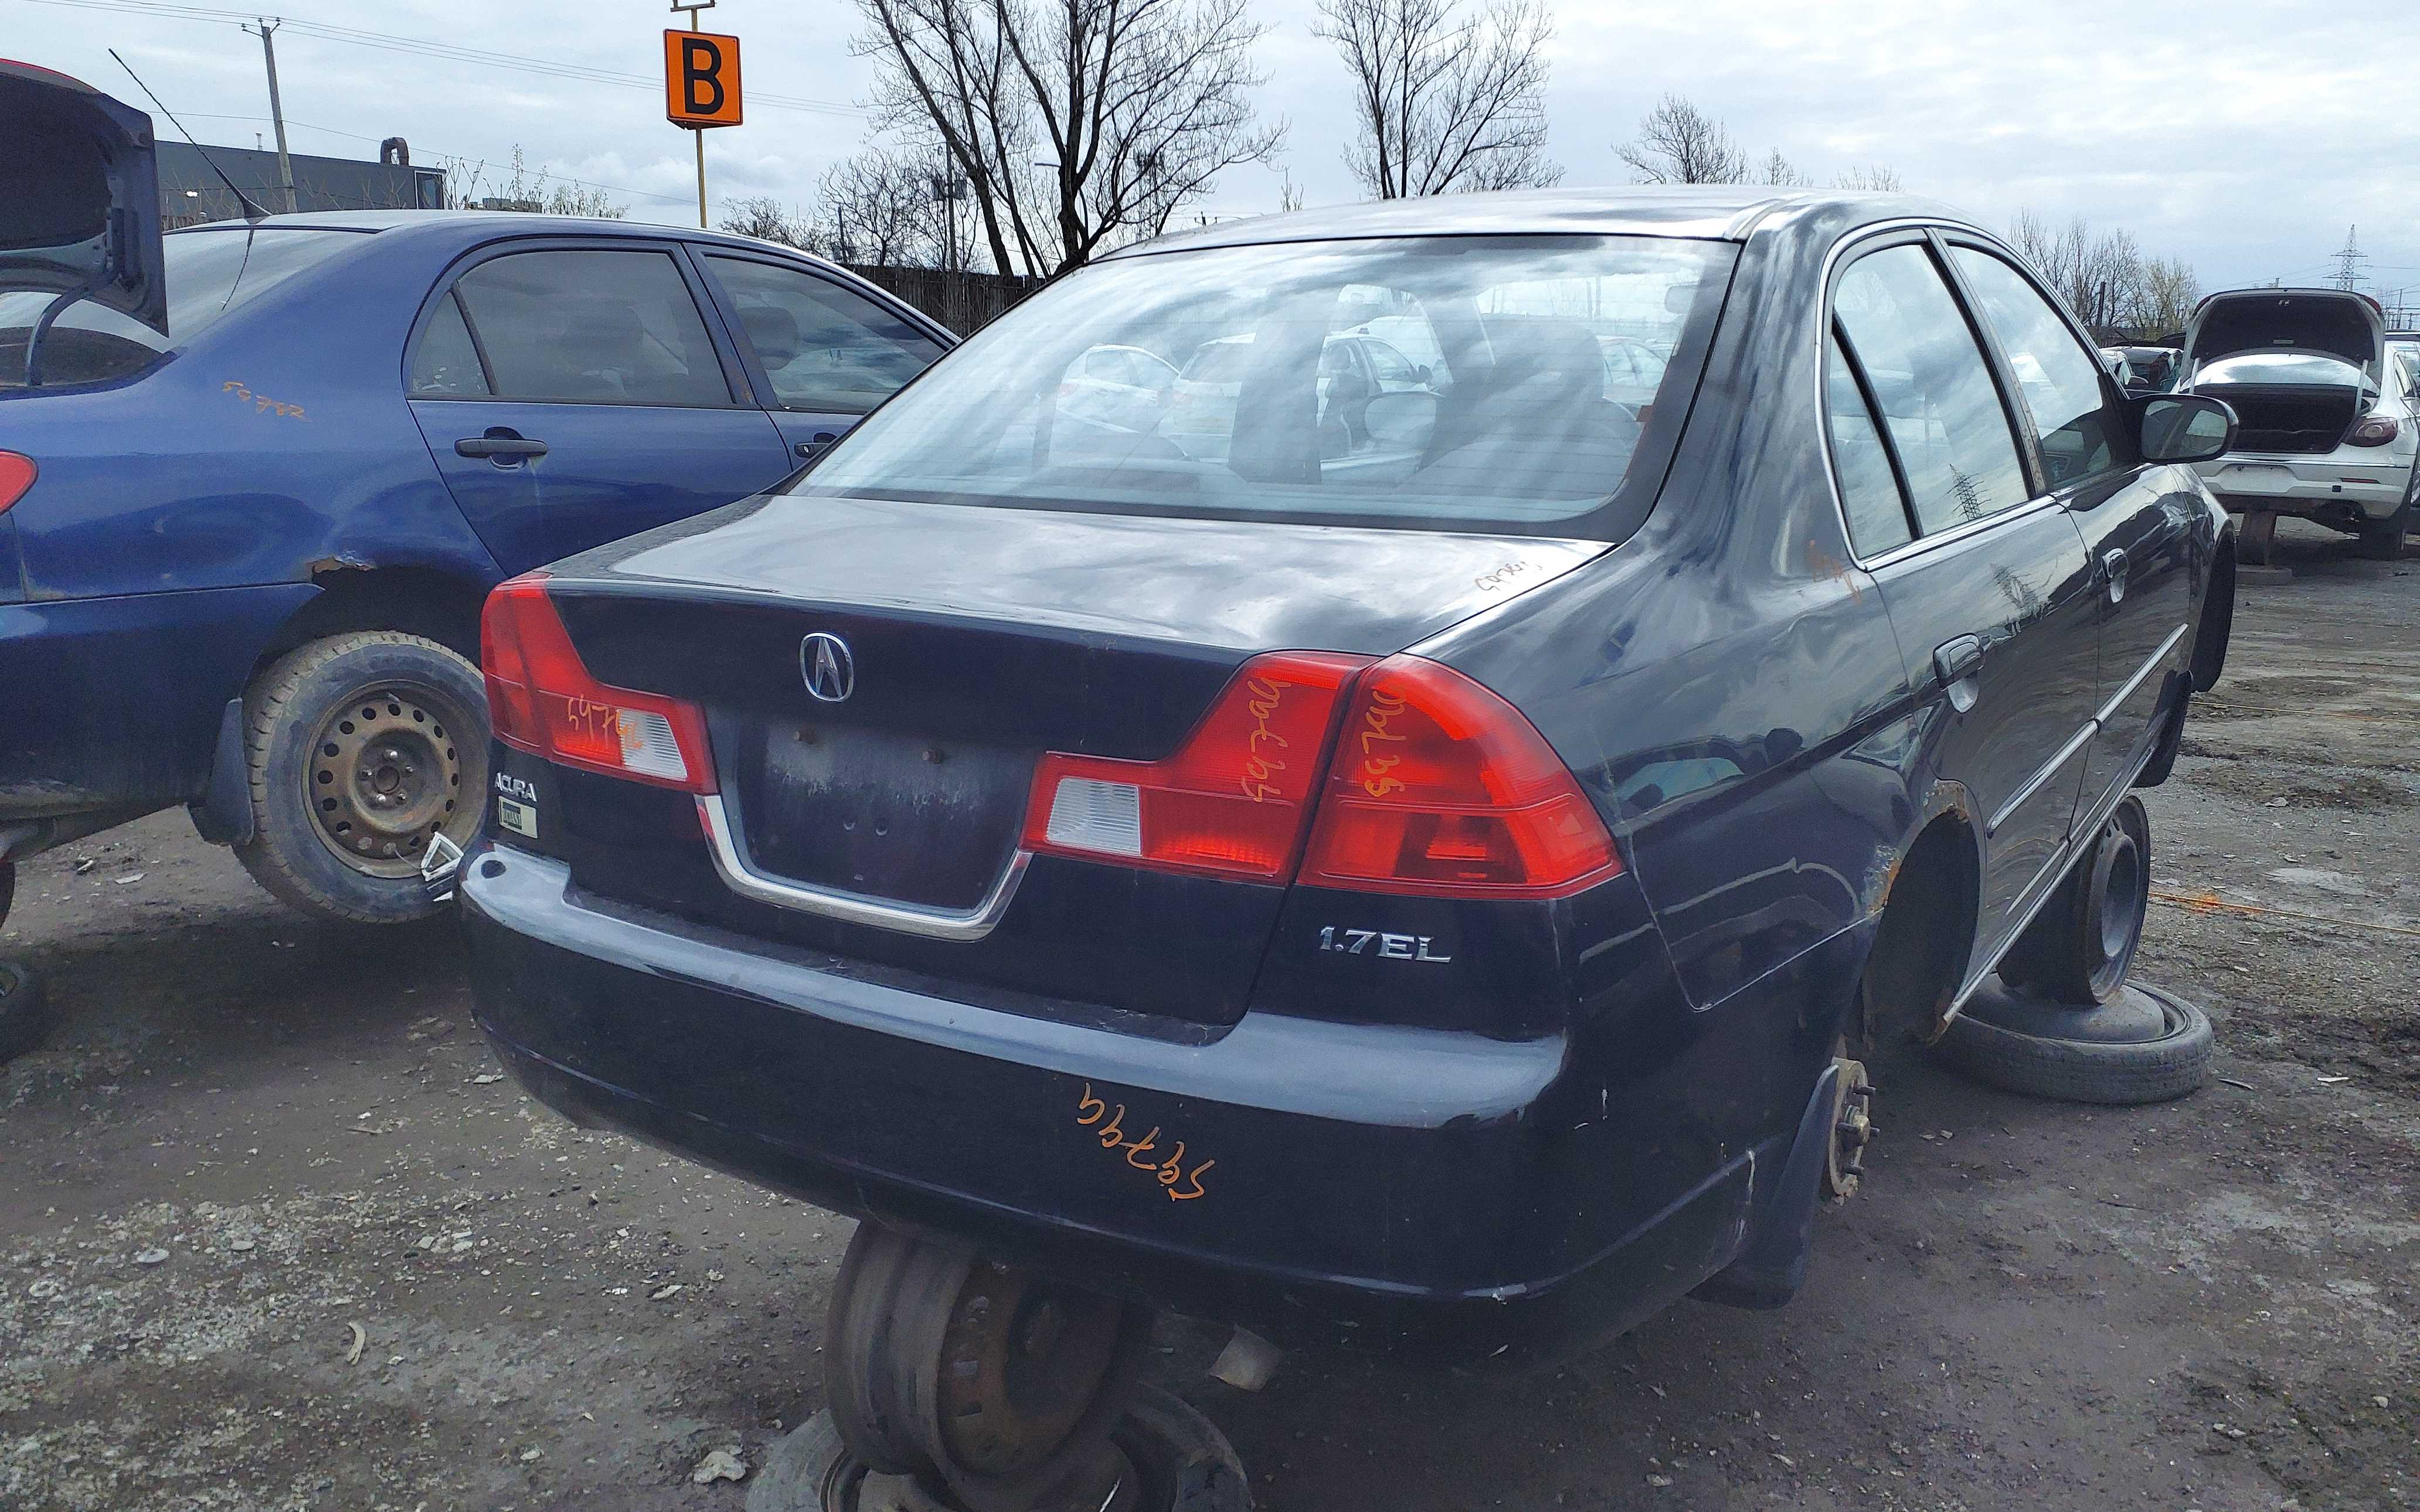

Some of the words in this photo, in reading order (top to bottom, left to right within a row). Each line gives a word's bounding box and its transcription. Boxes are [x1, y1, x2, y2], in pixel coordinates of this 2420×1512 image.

[682, 37, 725, 115] B
[494, 772, 538, 802] ACURA
[1320, 926, 1453, 963] 1.7EL
